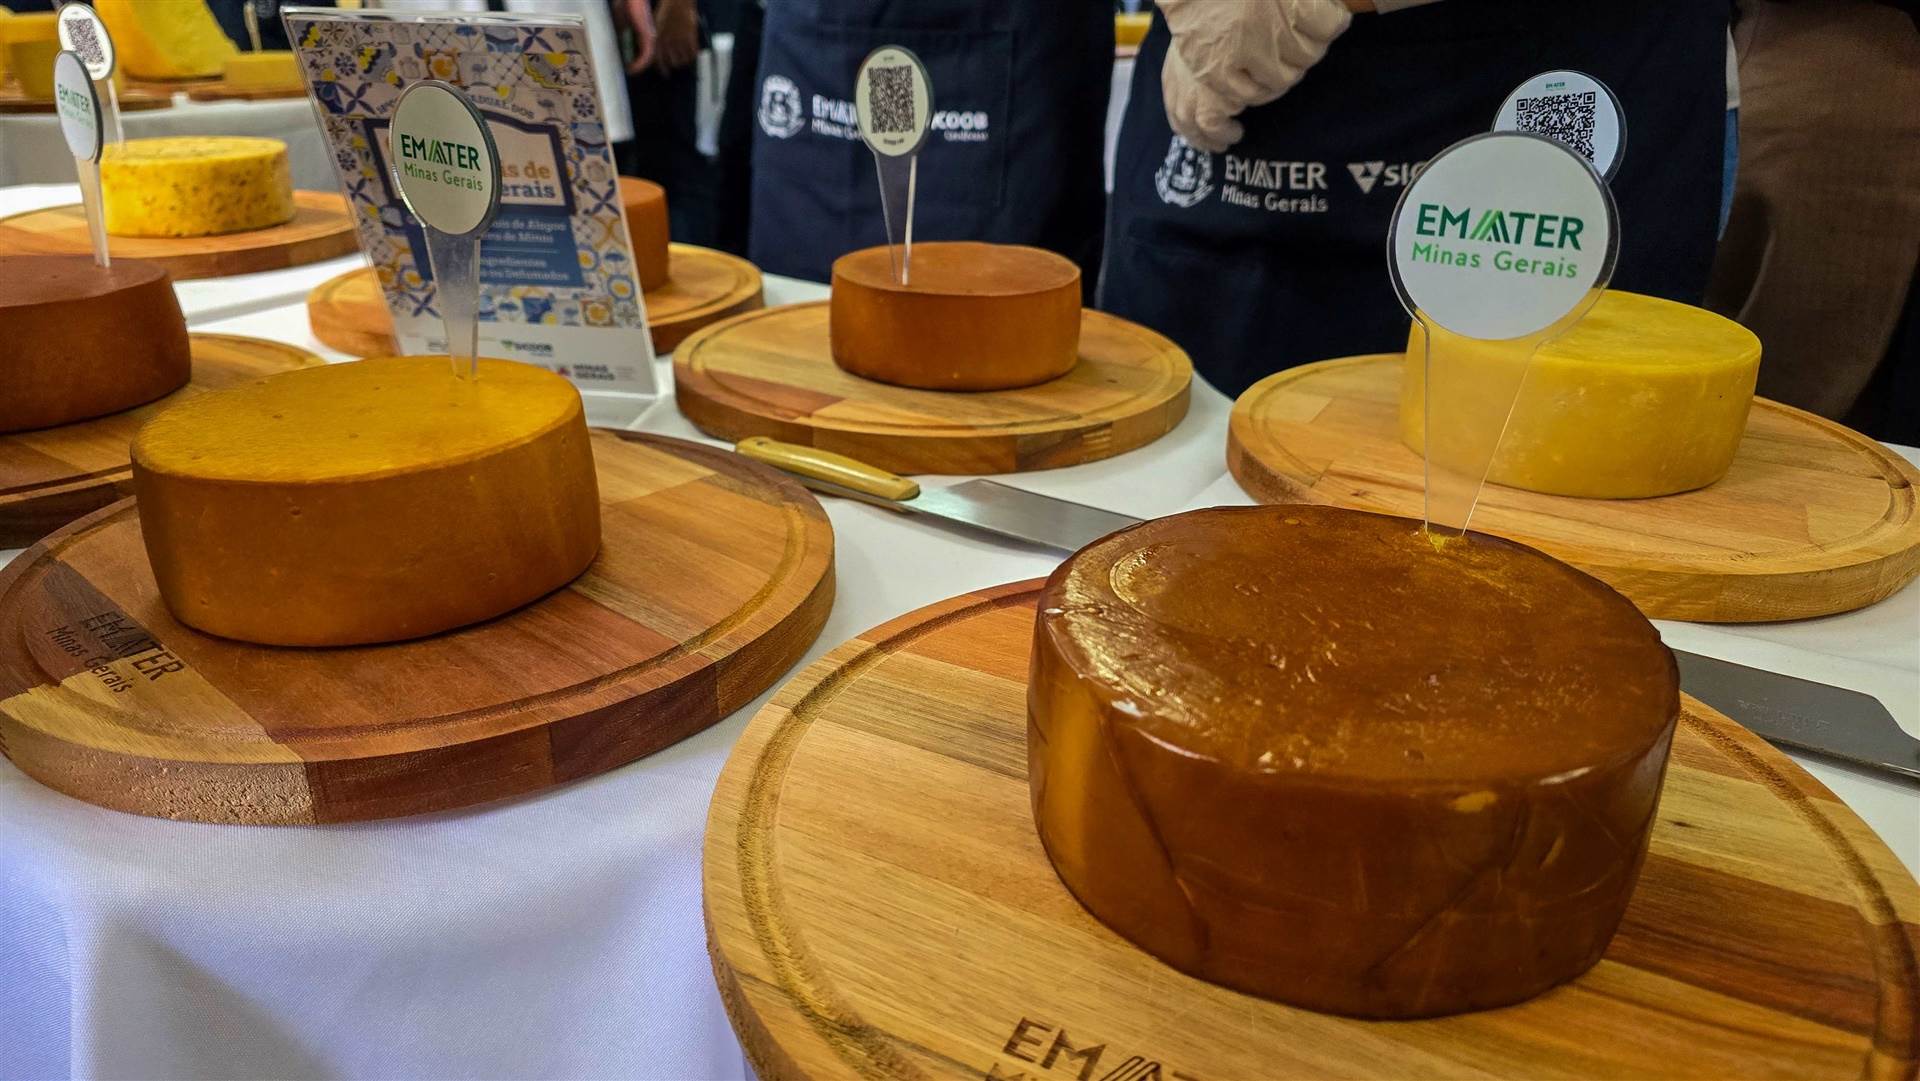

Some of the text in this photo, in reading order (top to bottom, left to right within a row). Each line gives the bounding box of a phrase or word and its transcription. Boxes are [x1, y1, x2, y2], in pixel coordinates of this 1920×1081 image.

[400, 133, 481, 171] EMATER
[523, 161, 552, 179] de
[403, 161, 483, 191] Minas Gerais
[501, 180, 555, 198] erais
[1225, 154, 1328, 190] EMATER
[1221, 184, 1329, 212] Minas Gerais
[1416, 203, 1584, 251] EMATER
[1411, 241, 1578, 278] Minas Gerais
[46, 625, 134, 693] Minas Gerais
[80, 611, 185, 681] EMATER
[1002, 1016, 1201, 1081] EMA
